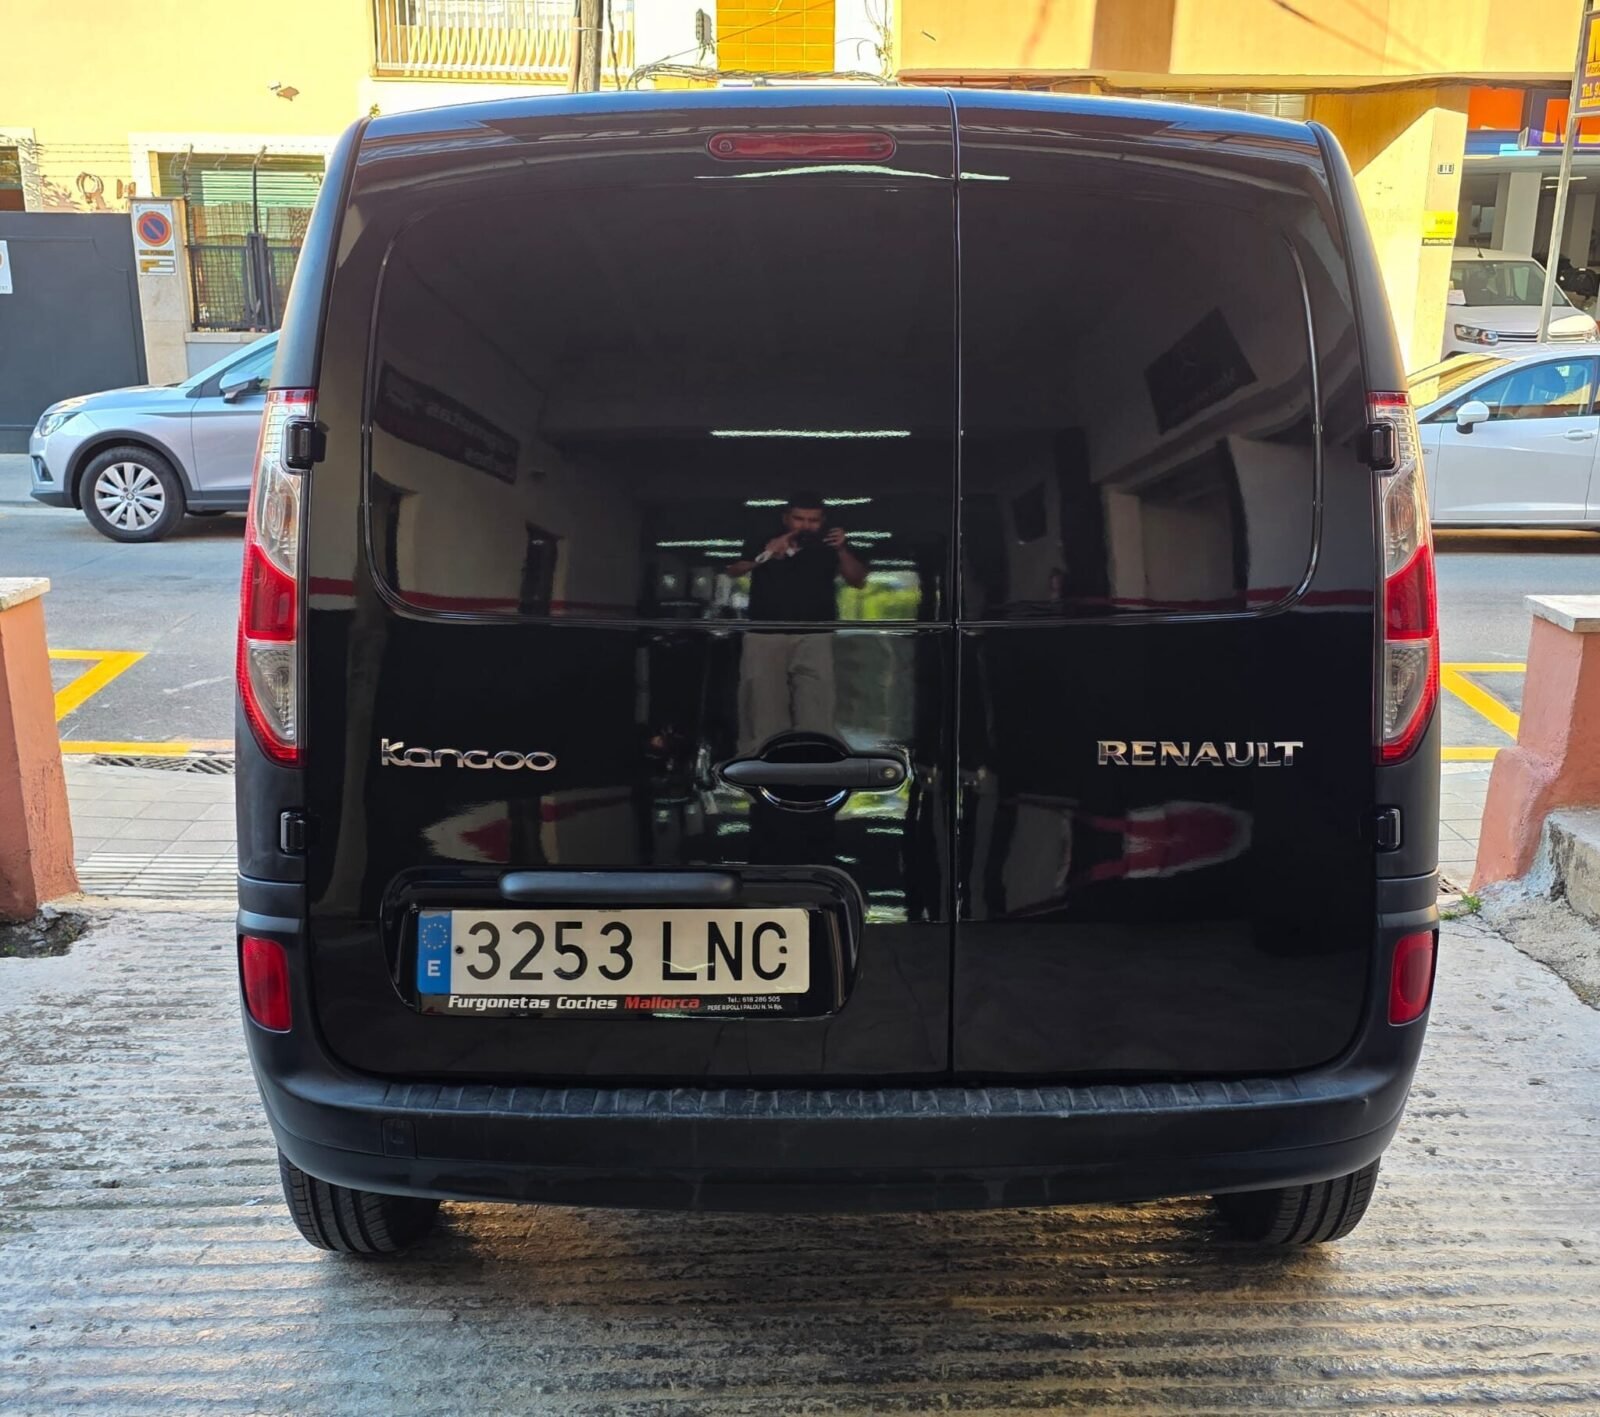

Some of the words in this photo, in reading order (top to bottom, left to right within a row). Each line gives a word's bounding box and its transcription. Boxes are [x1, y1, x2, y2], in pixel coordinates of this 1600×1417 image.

[1097, 740, 1304, 767] RENAULT
[466, 921, 634, 980] 3253
[662, 921, 788, 981] LNC
[427, 960, 441, 977] E
[448, 995, 550, 1012] Furgonetas
[556, 996, 618, 1010] Coches
[624, 996, 701, 1010] Mallorca
